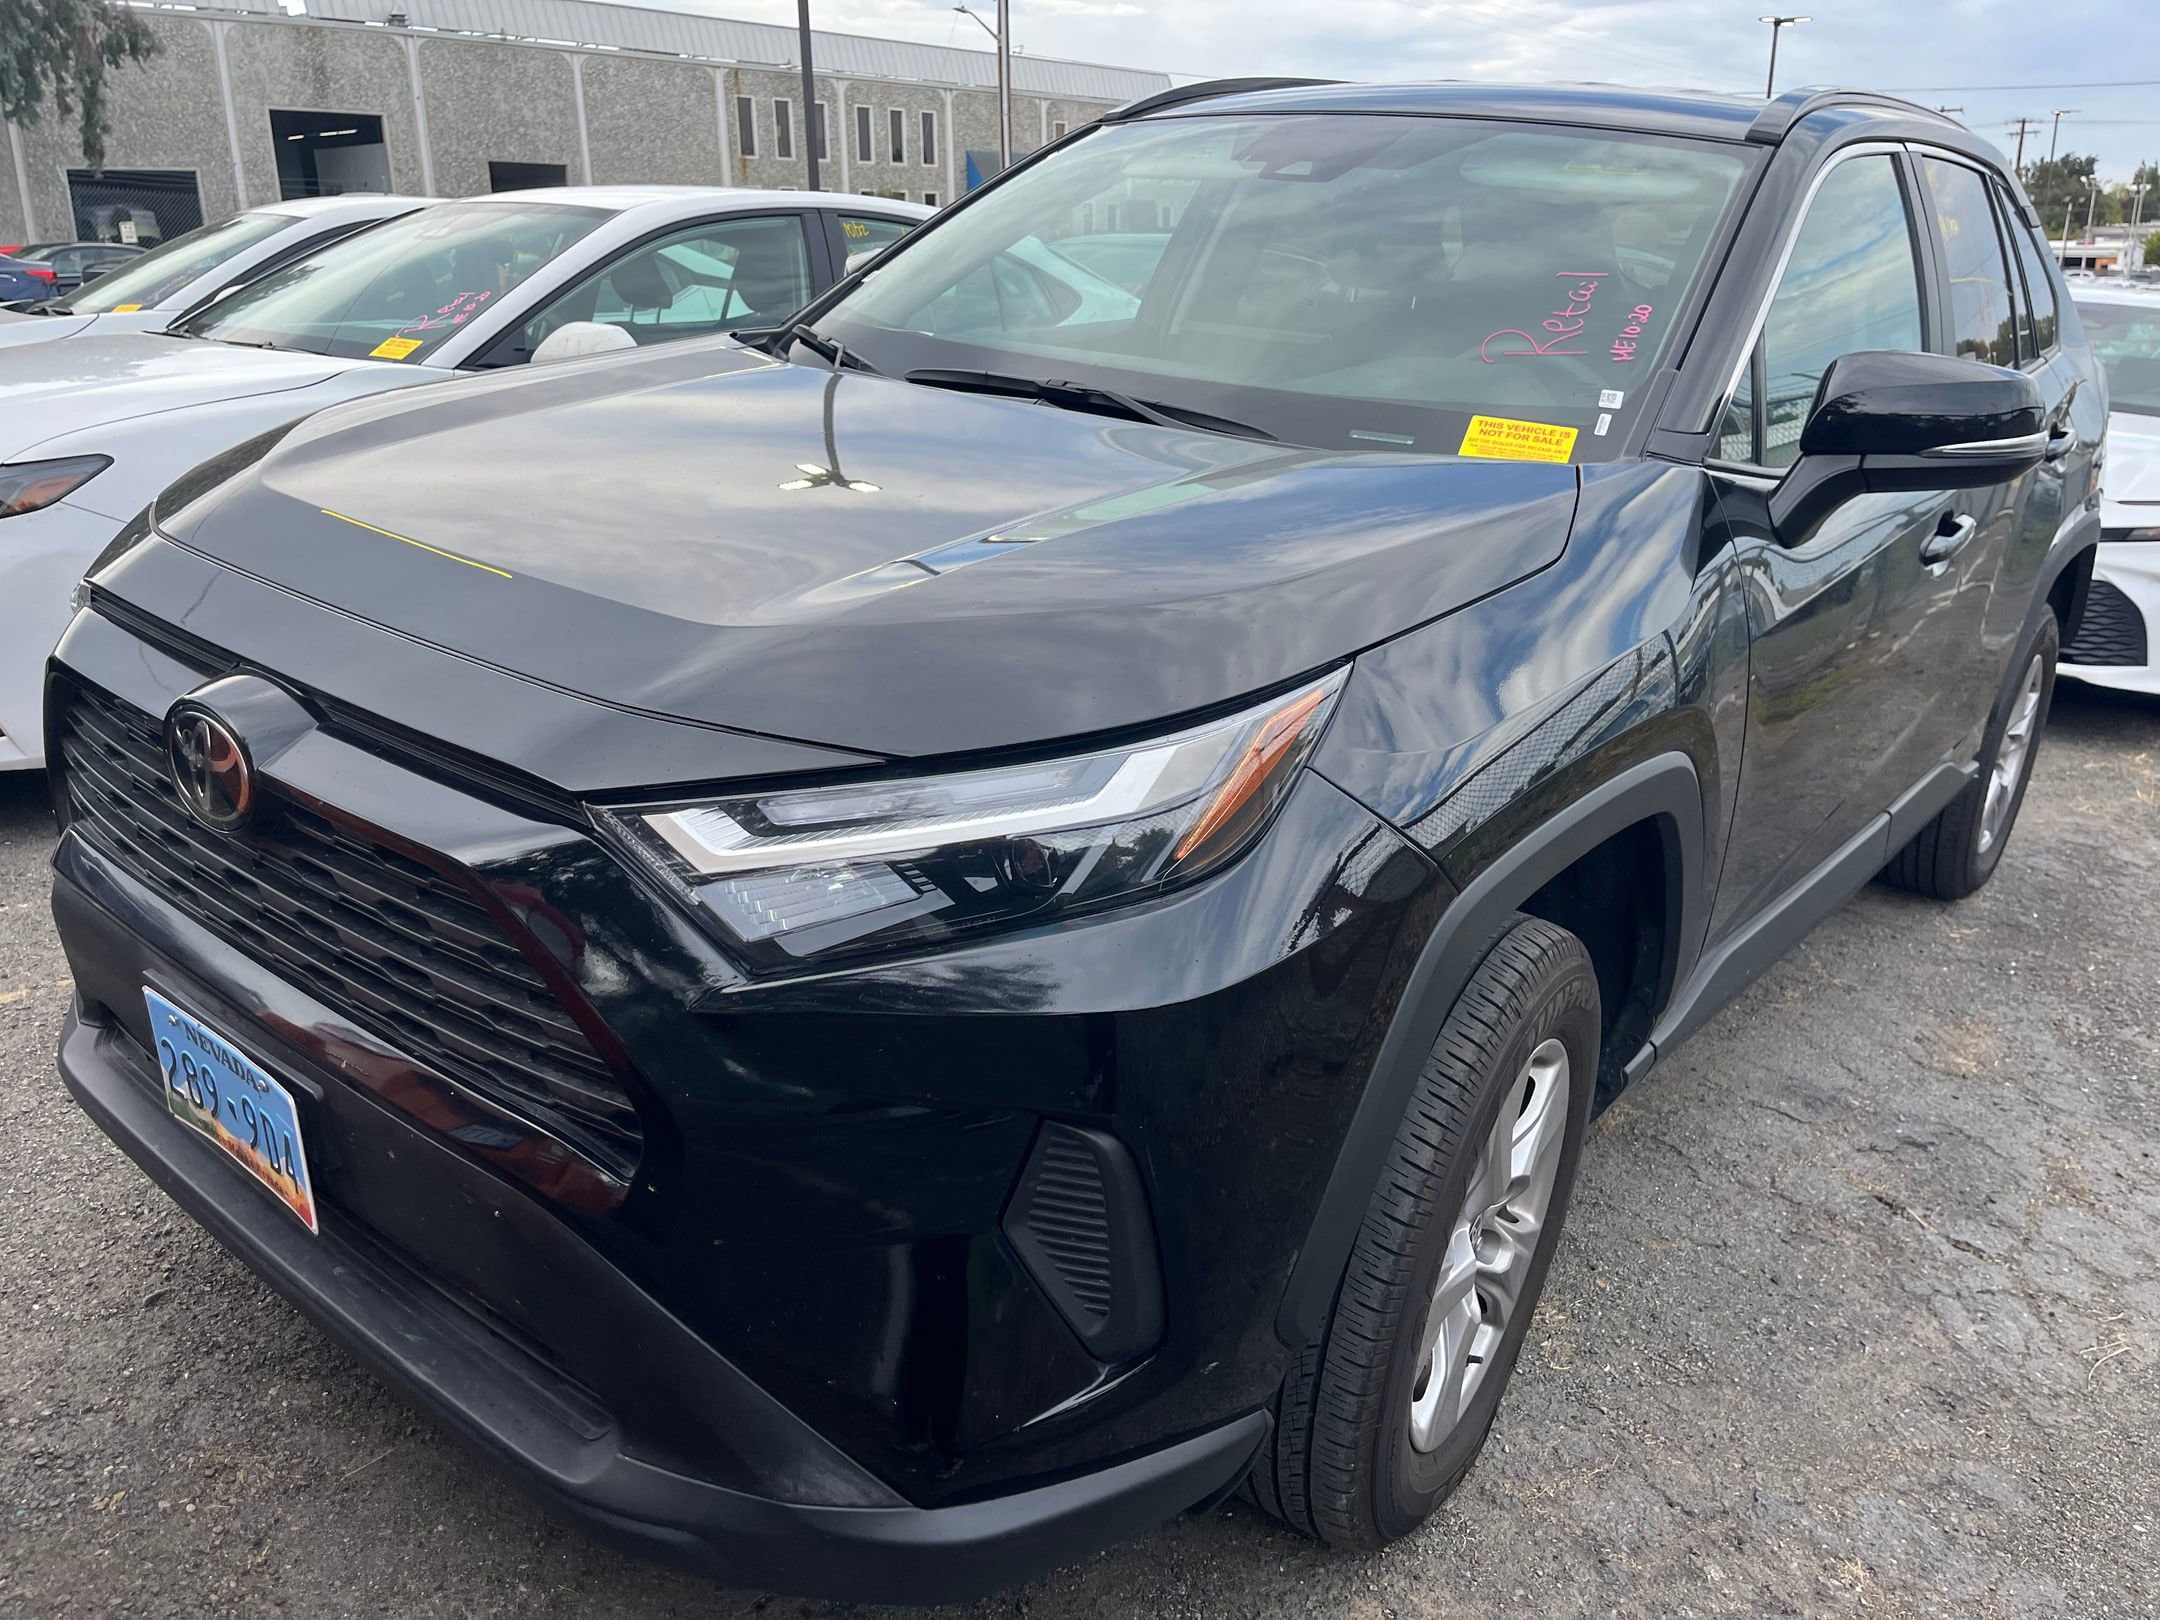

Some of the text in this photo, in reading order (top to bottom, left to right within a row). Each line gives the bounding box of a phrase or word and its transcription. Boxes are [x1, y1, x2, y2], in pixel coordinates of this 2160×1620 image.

[1481, 271, 1609, 363] Retail
[1478, 419, 1571, 439] THIS VEHICLE IS
[1478, 428, 1564, 446] NOT FOR SALE
[183, 1021, 262, 1094] NEVADA
